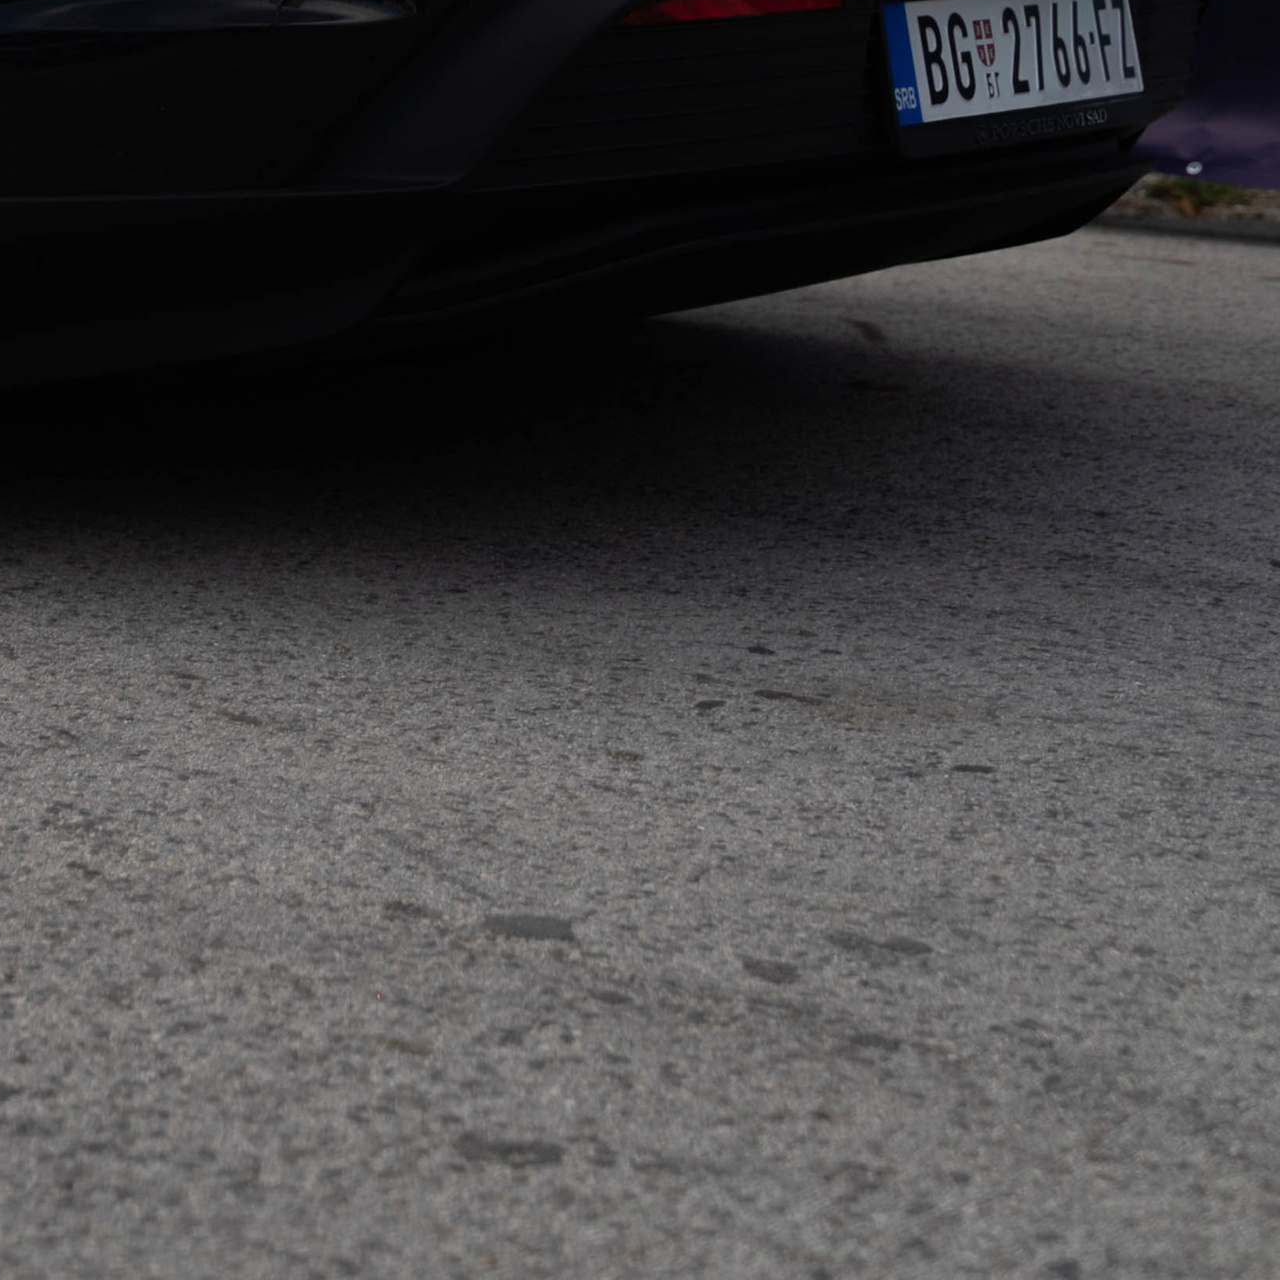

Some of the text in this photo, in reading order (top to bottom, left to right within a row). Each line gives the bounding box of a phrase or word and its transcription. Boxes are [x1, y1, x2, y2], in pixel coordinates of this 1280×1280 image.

[917, 12, 977, 107] BG
[894, 86, 918, 112] SRB
[1057, 111, 1086, 132] NOVI
[1085, 108, 1109, 126] SAD
